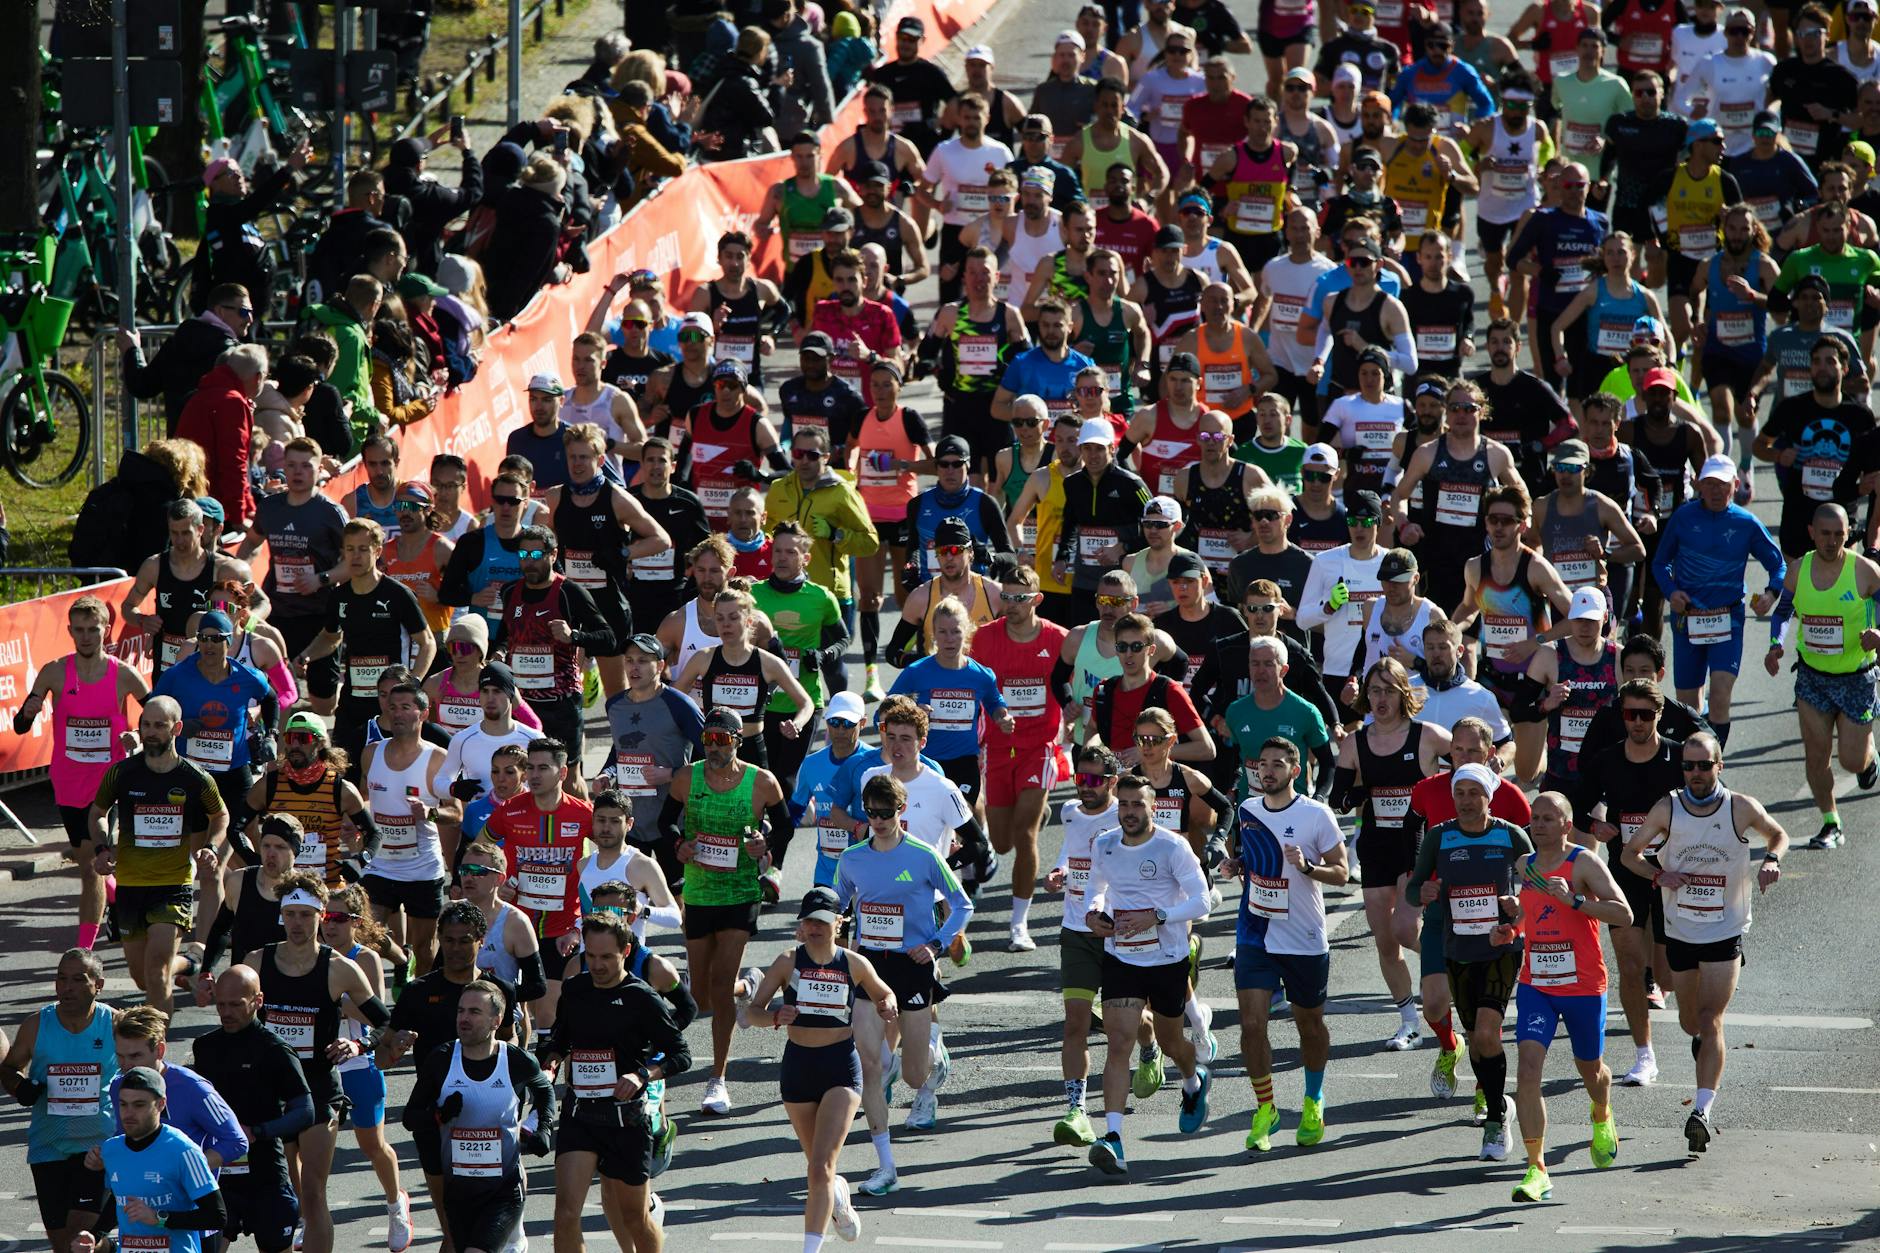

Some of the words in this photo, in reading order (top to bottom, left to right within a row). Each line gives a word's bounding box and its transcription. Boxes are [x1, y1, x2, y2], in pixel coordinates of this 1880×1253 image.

[1557, 242, 1594, 250] KASPER
[1355, 464, 1387, 473] UpDo
[572, 561, 593, 569] 3834
[1493, 617, 1524, 625] GENERALI
[1491, 627, 1519, 635] 24467
[1808, 627, 1834, 635] 40668
[356, 668, 380, 676] 39091
[725, 676, 756, 684] GENERALI
[1012, 677, 1044, 686] GENERALI
[1569, 681, 1606, 690] SAYSKY
[721, 687, 749, 695] 19723
[942, 690, 973, 699] GENERALI
[940, 701, 966, 710] 54021
[448, 707, 476, 715] 62043
[1572, 709, 1596, 717] GENER
[200, 731, 231, 740] GENERALI
[195, 740, 224, 749] 55455
[624, 756, 651, 764] GENERALI
[622, 766, 643, 774] 1927
[816, 802, 833, 811] BER
[1154, 800, 1179, 808] NERALI
[1380, 798, 1408, 807] 26261
[147, 806, 181, 814] GENERALI
[1154, 811, 1172, 819] 142
[383, 817, 414, 825] GENERALI
[381, 827, 407, 836] 15055
[826, 830, 847, 839] 1483
[704, 836, 736, 846] GENERALI
[295, 844, 317, 854] 097
[700, 846, 728, 856] 23194
[532, 865, 564, 873] GENERALI
[528, 876, 557, 884] 18865
[1072, 872, 1089, 880] 5263
[1258, 875, 1286, 888] GENERALI
[1254, 888, 1278, 899] 31541
[1461, 887, 1494, 896] GENERALI
[1686, 887, 1715, 896] 23862
[1458, 898, 1488, 908] 61848
[869, 905, 900, 914] GENERALI
[866, 916, 894, 925] 24536
[1539, 943, 1571, 951] GENERALI
[1537, 955, 1566, 963] 24105
[812, 973, 846, 982] GENERALI
[808, 984, 840, 993] 14393
[276, 1014, 312, 1024] GENERALI
[274, 1026, 304, 1036] 36193
[579, 1052, 612, 1060] GENERALI
[61, 1064, 97, 1074] GENERALI
[578, 1065, 606, 1073] 26263
[59, 1077, 89, 1086] 50711
[463, 1130, 498, 1139] GENERALI
[460, 1142, 491, 1151] 52212
